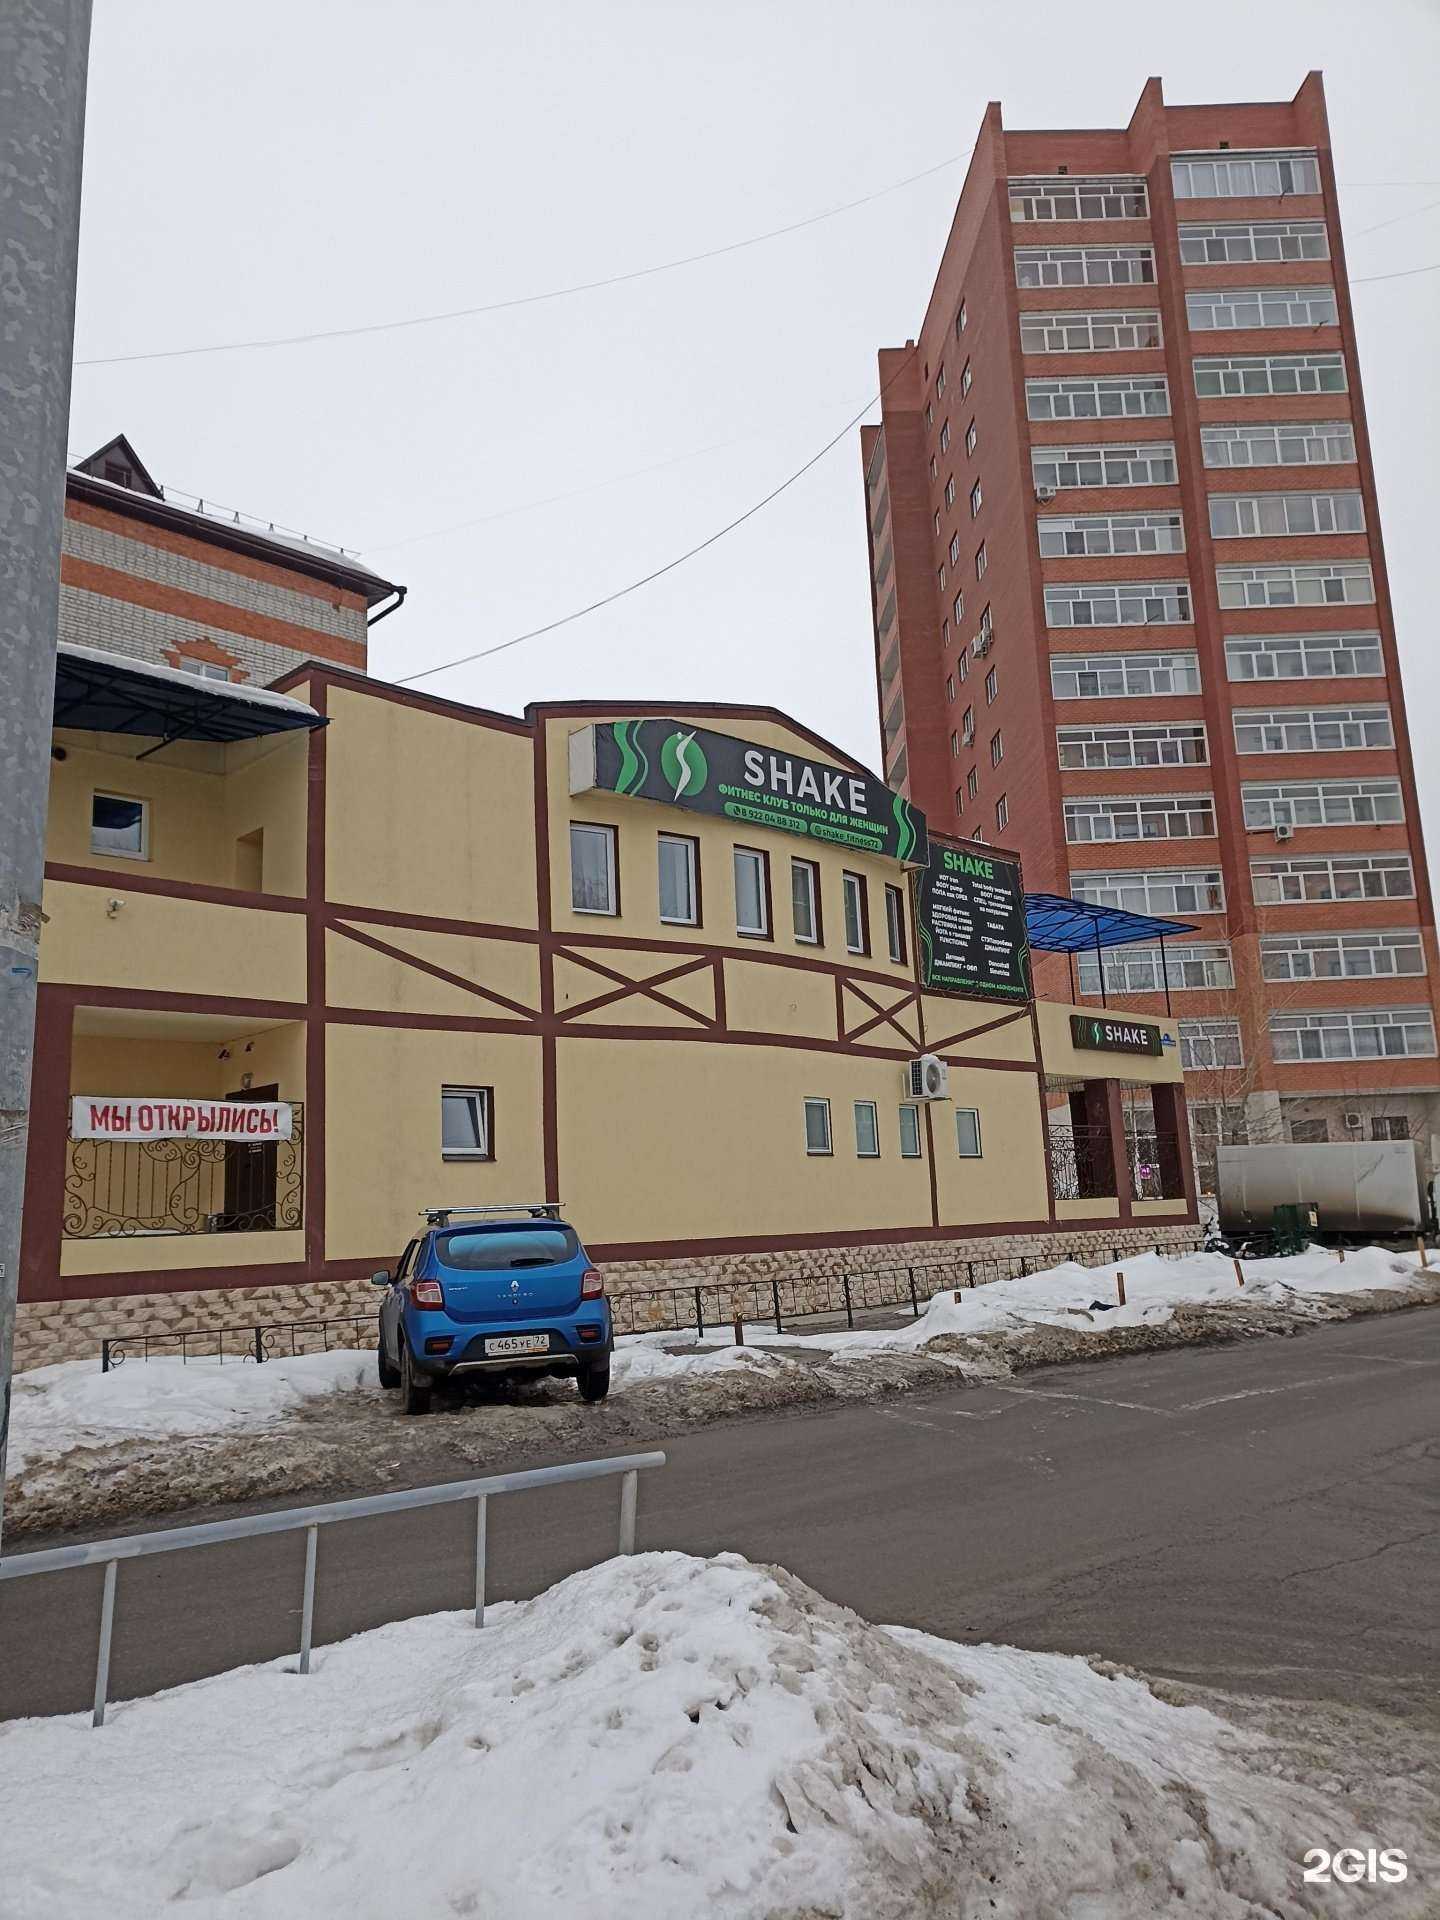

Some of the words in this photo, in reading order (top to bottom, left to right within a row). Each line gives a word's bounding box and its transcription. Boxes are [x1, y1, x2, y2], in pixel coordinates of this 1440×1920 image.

[744, 750, 868, 815] SHAKE
[718, 783, 761, 803] ФИТНЕС
[763, 794, 789, 809] КЛУБ
[790, 801, 828, 819] ТОЛЬКО
[829, 811, 848, 825] ДЛЯ
[849, 816, 889, 835] ЖЕНЩИН
[748, 810, 763, 820] 922
[943, 851, 994, 880] SHAKE
[1105, 1025, 1149, 1045] SHAKE
[90, 1104, 131, 1132] МЫ
[138, 1104, 278, 1134] ОТКРЫЛИСЬ!
[534, 1335, 546, 1345] 72
